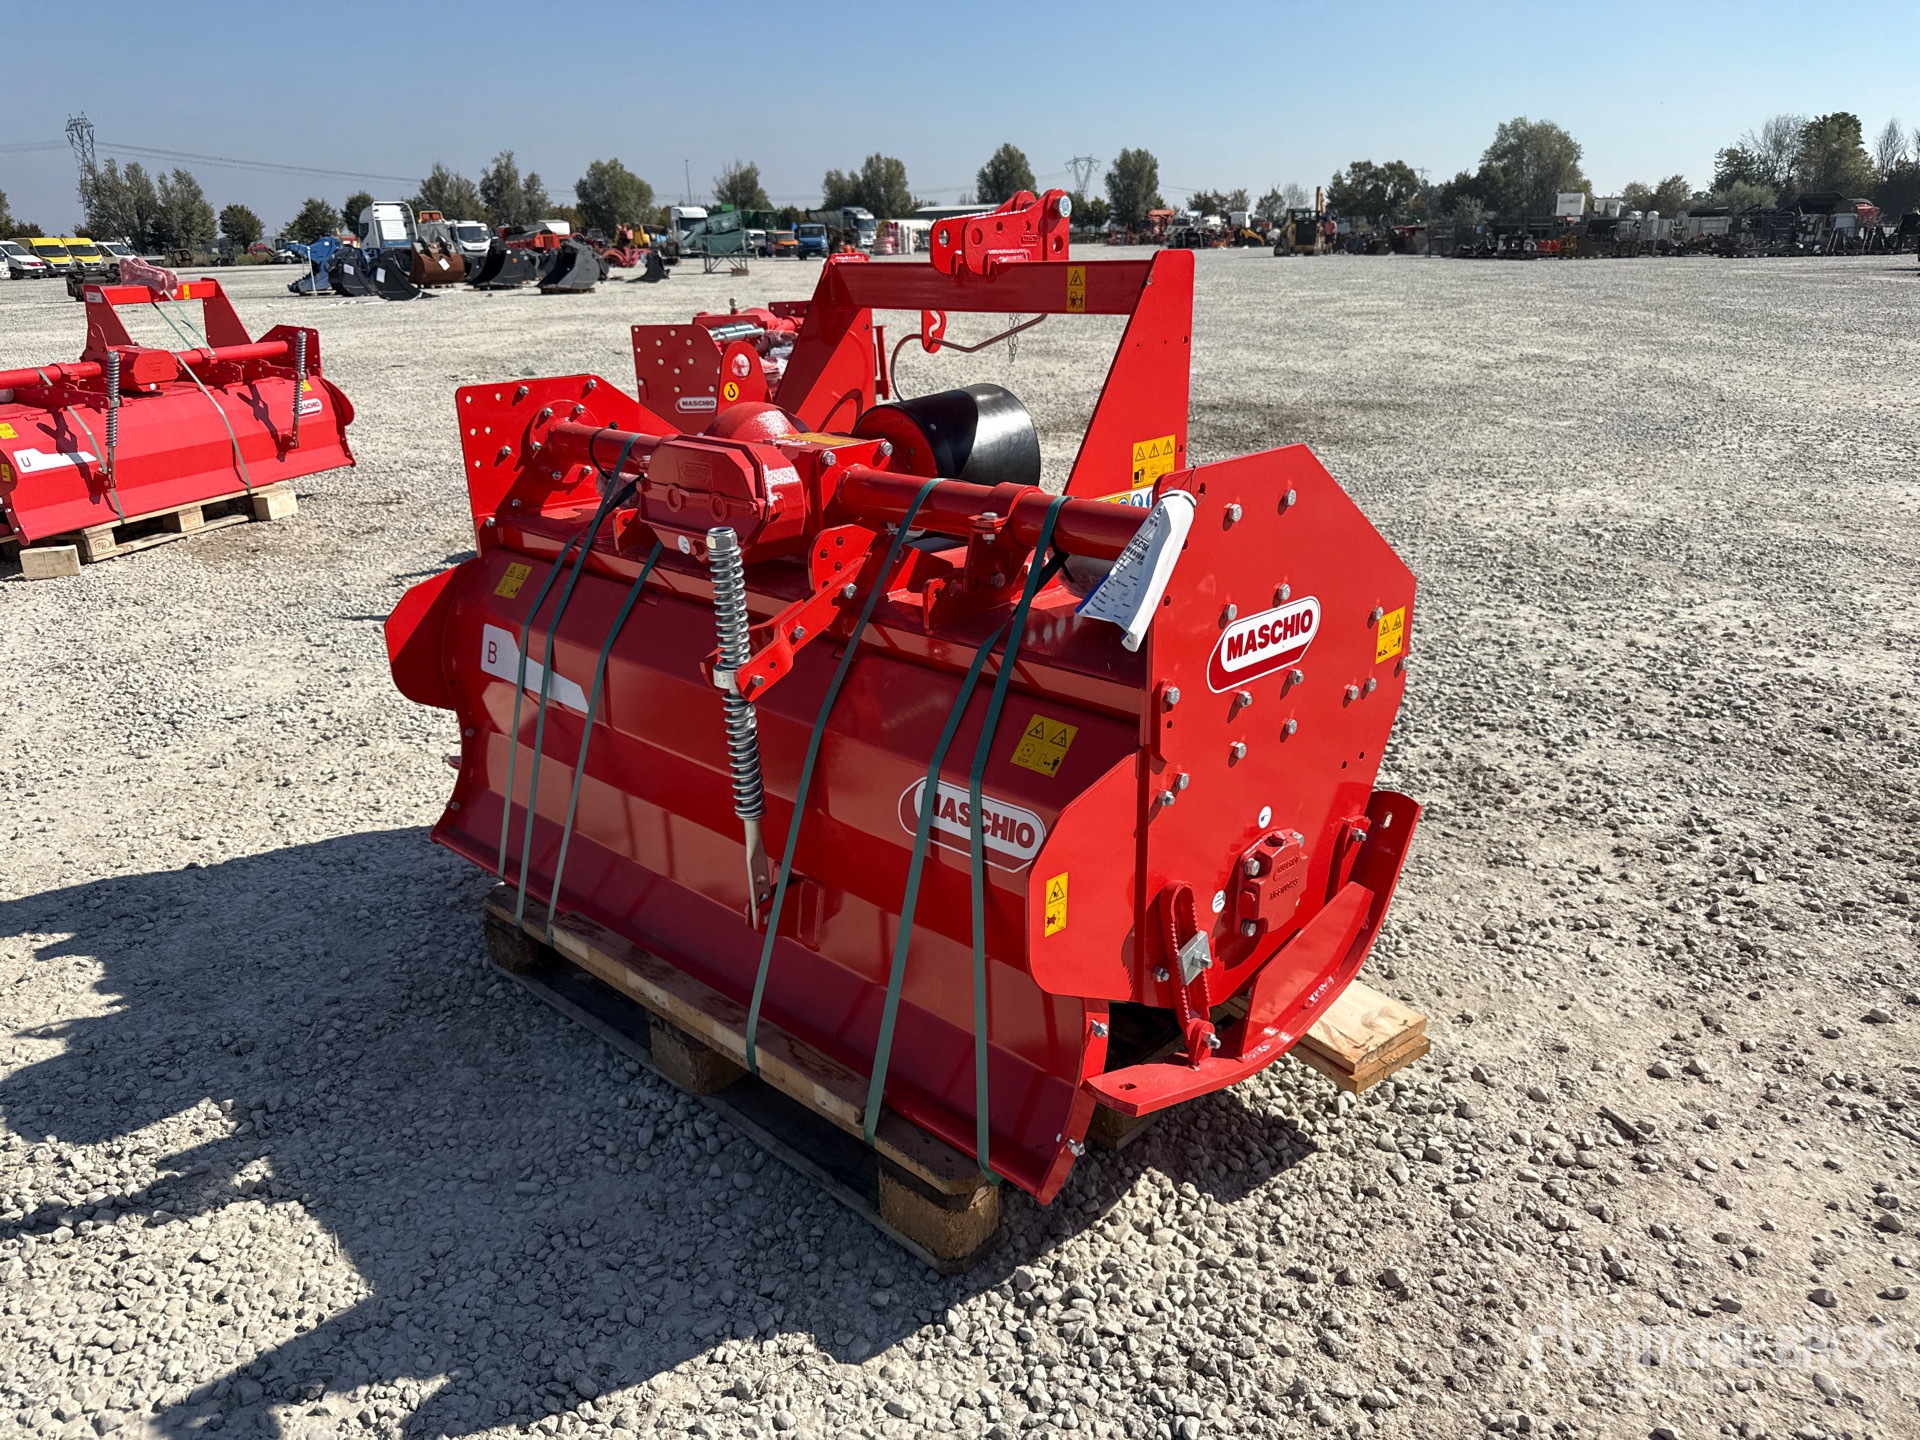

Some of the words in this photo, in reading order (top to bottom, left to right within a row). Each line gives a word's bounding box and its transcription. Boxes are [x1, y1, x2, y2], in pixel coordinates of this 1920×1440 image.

[20, 456, 31, 468] U
[1226, 608, 1313, 662] MASCHIO
[487, 641, 498, 665] B
